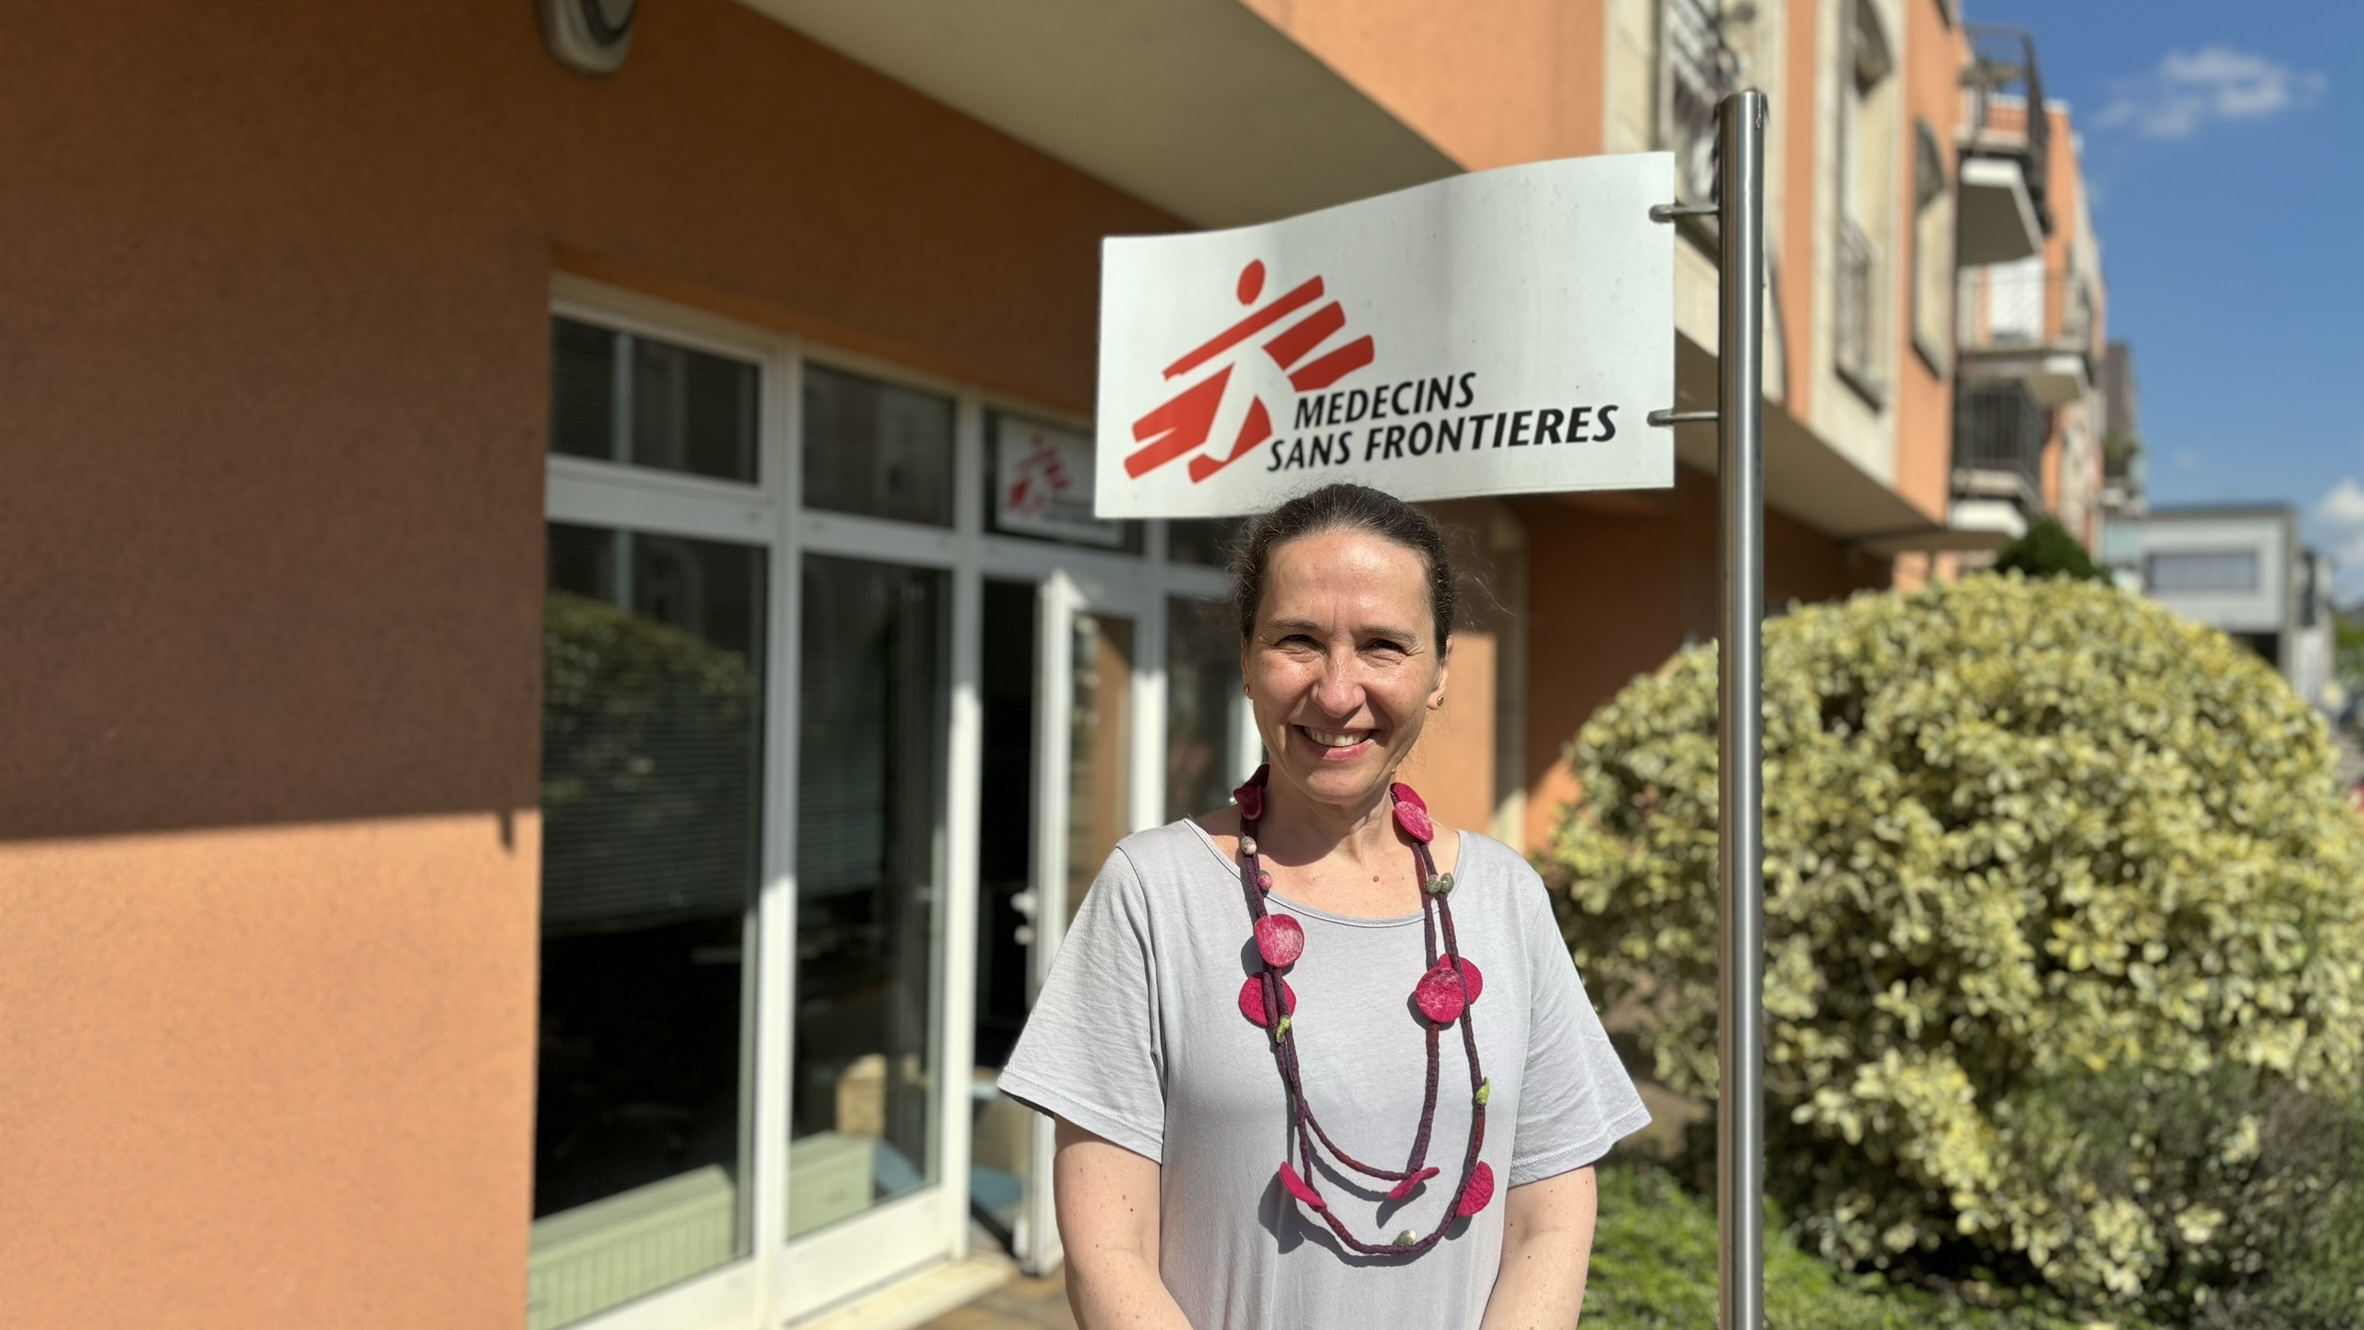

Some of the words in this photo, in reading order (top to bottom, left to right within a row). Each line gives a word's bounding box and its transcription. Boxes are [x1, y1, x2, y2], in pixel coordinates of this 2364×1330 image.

[1295, 373, 1476, 429] MEDECINS
[1267, 432, 1352, 472] SANS
[1365, 405, 1619, 460] FRONTIERES
